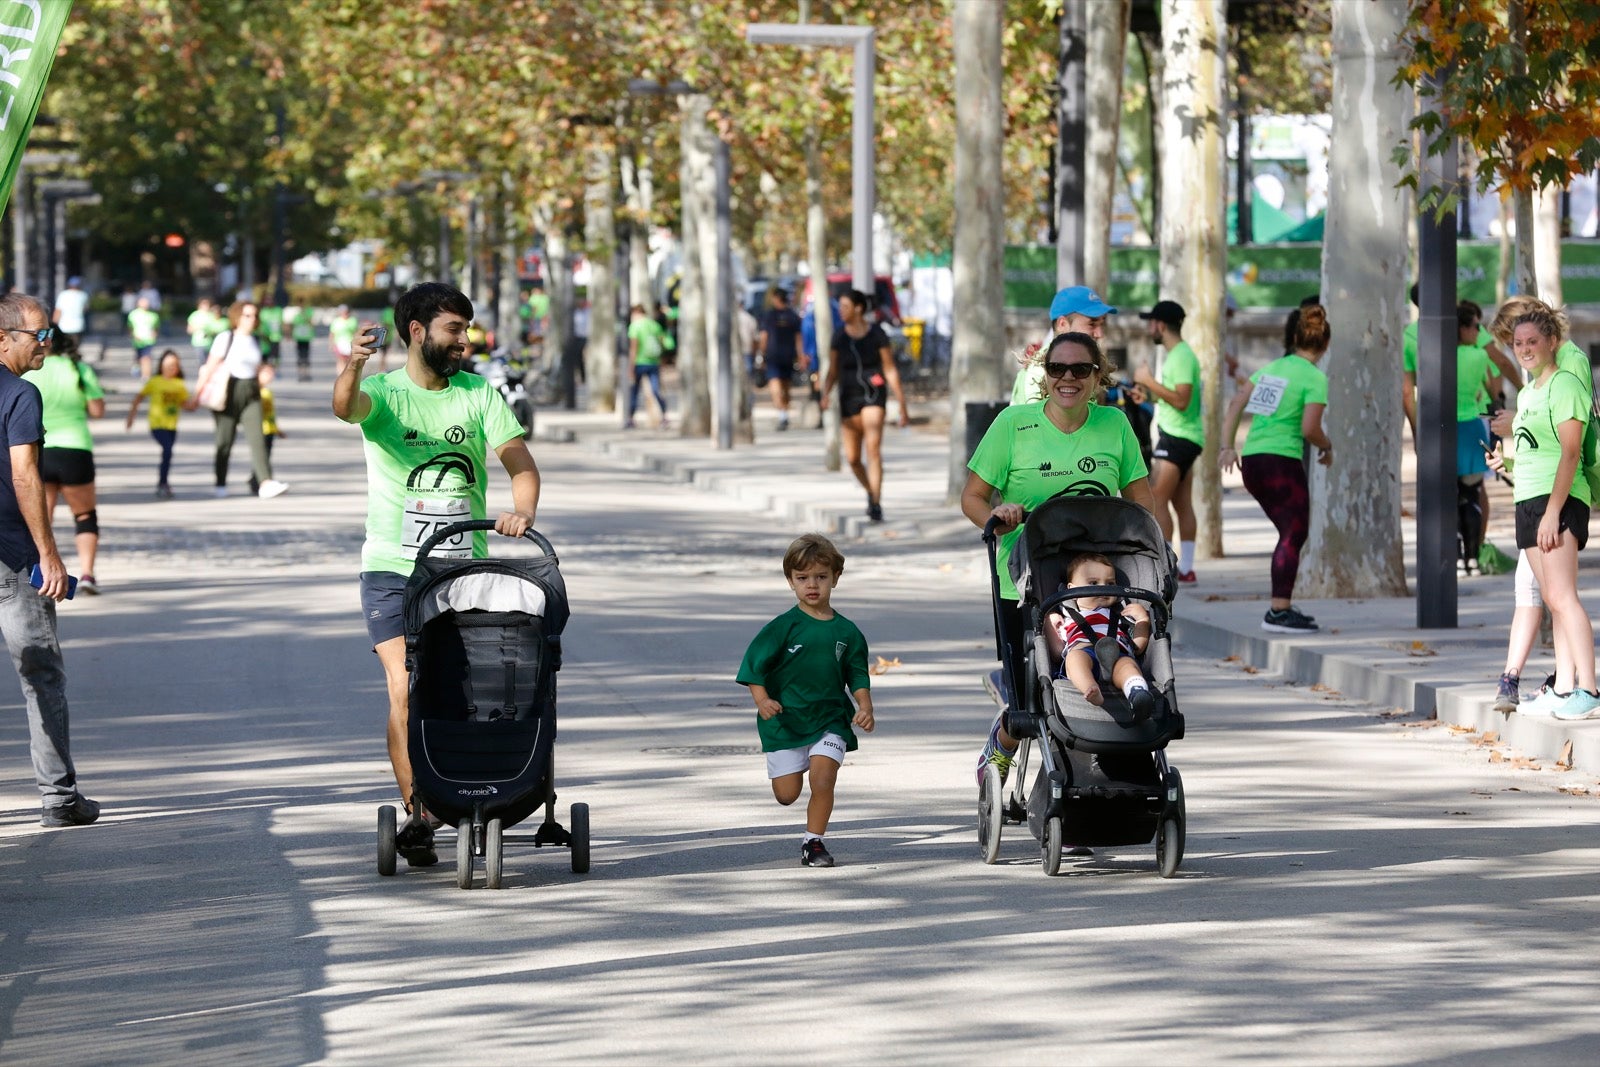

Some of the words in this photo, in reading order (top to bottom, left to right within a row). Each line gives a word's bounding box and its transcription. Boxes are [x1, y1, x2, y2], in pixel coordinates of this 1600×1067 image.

[1253, 386, 1277, 404] 205
[1041, 470, 1074, 478] IBERDROLA
[458, 788, 472, 796] city
